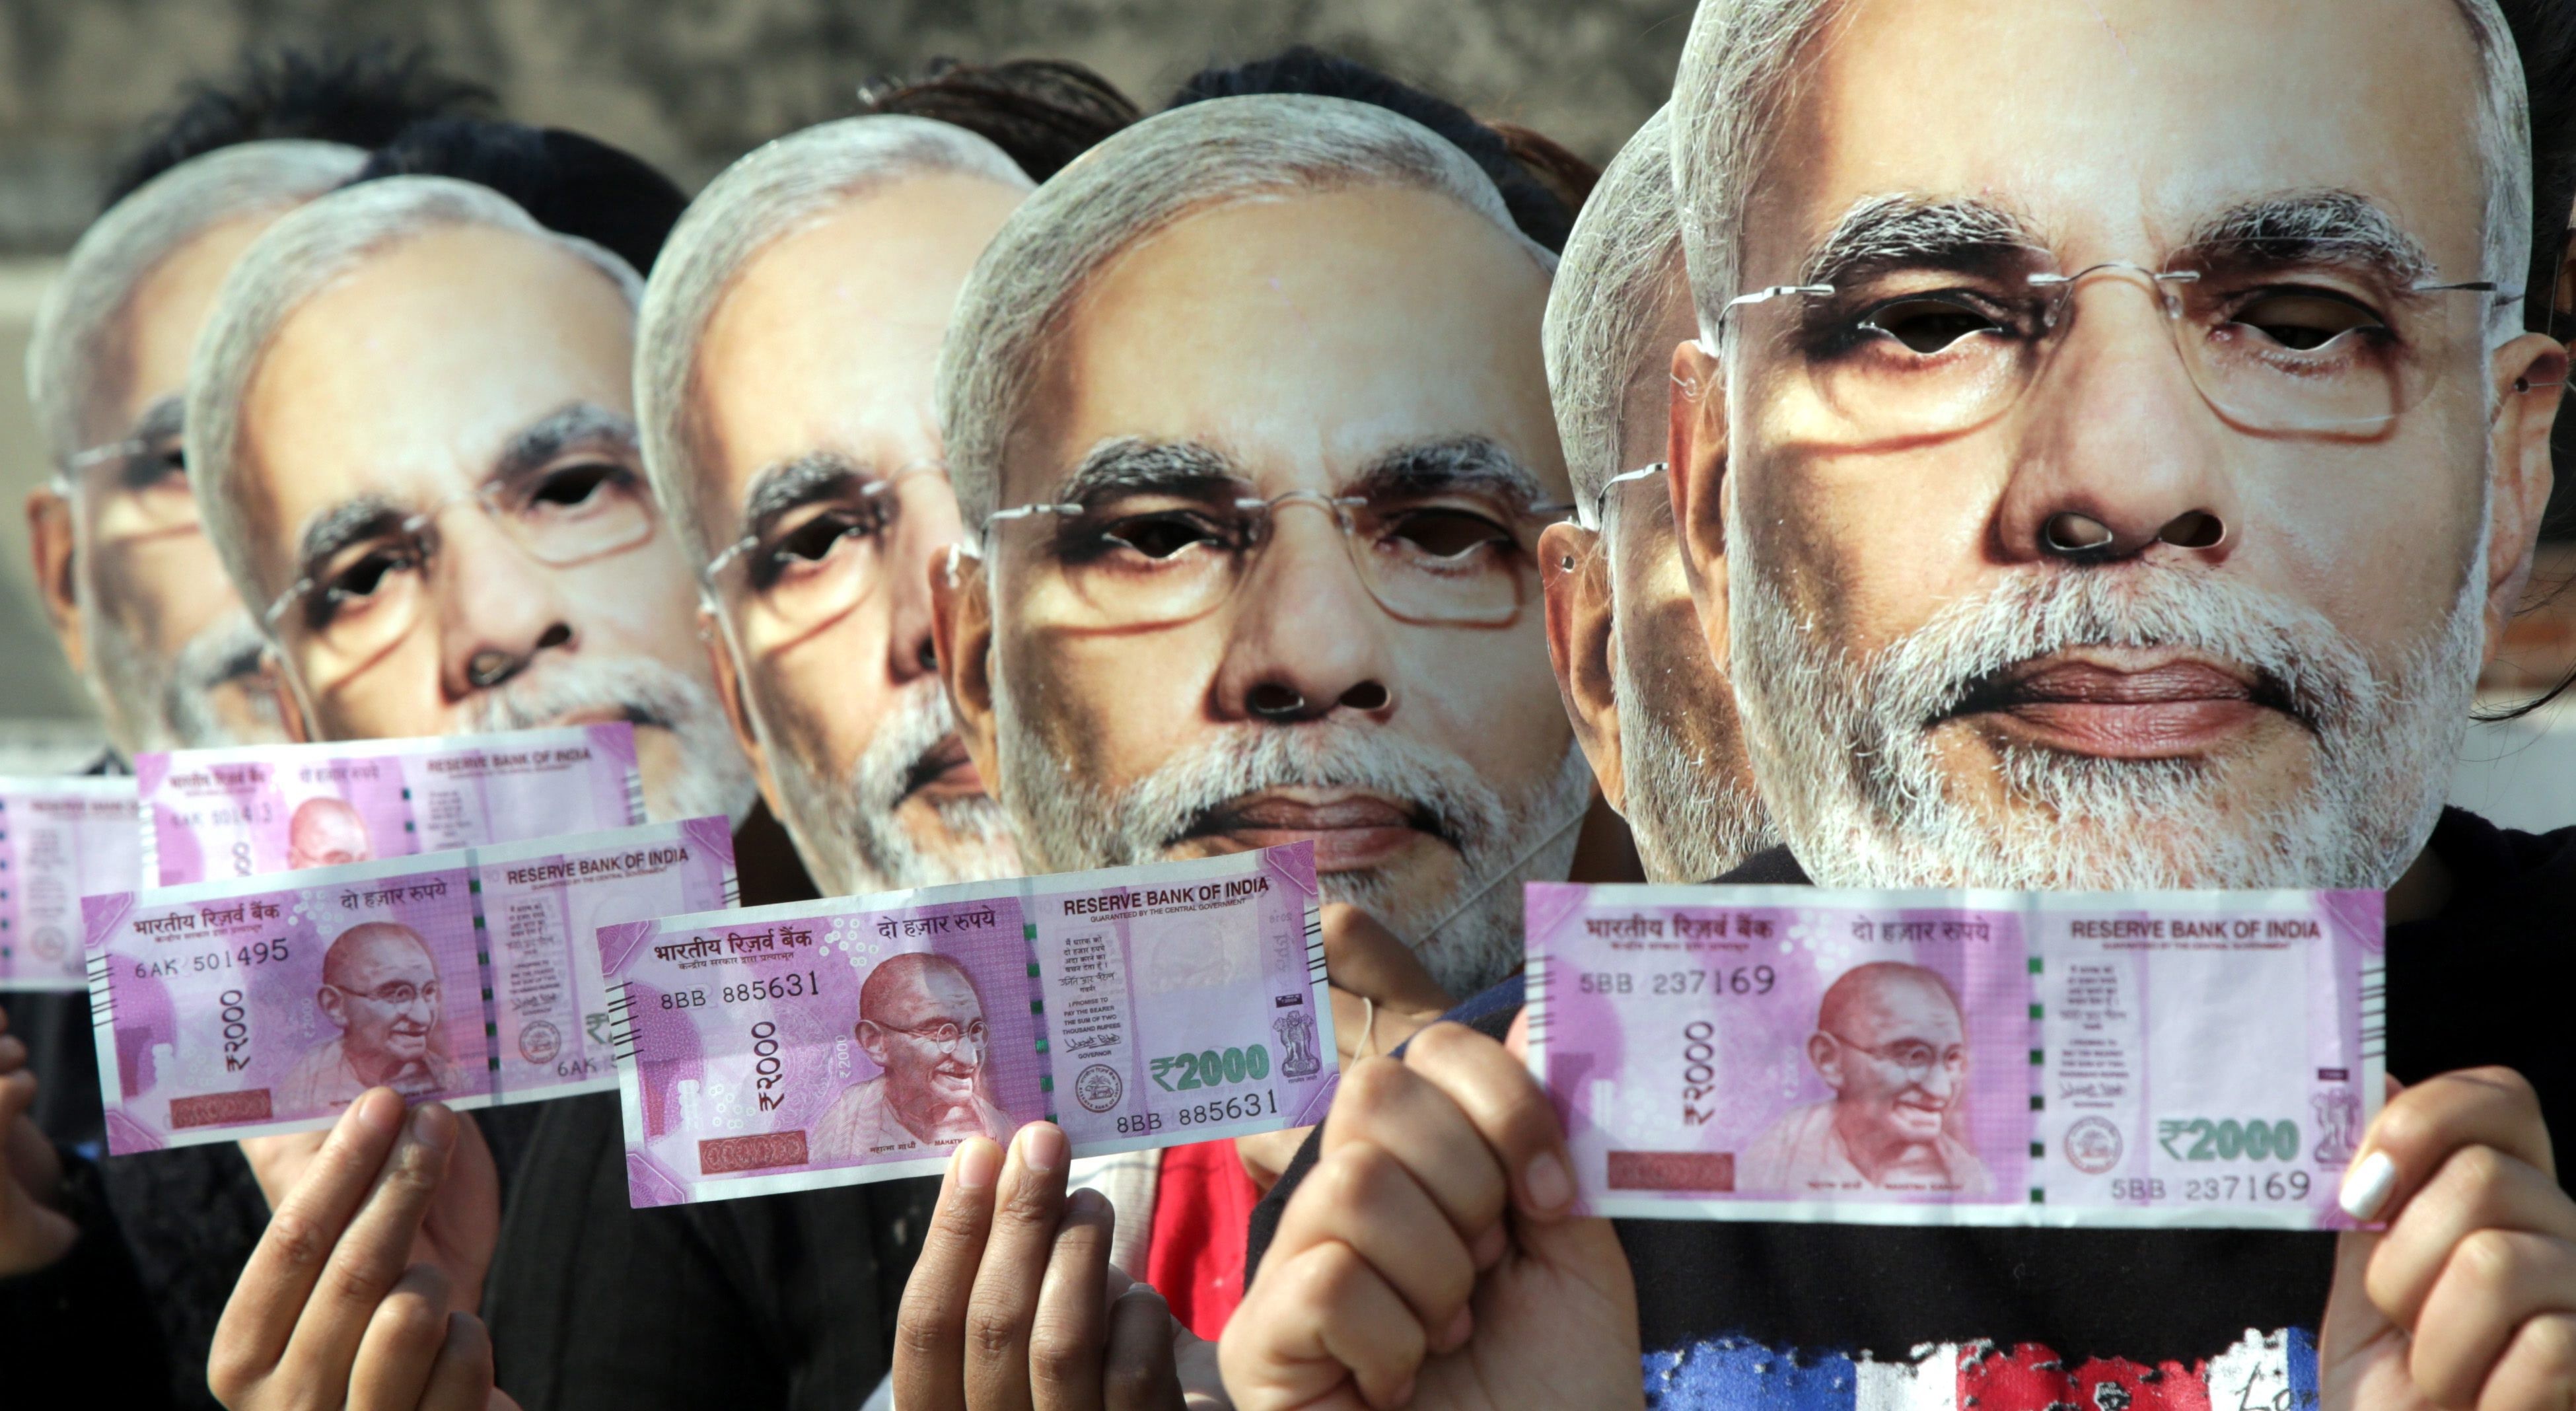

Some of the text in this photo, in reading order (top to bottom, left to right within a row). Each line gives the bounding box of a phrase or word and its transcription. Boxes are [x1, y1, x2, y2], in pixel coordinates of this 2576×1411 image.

[507, 848, 689, 885] RESERVE BANK OF INDIA
[340, 877, 447, 910] दो हज़ार रुपये
[1064, 877, 1270, 916] RESERVE BANK OF INDIA
[133, 900, 280, 935] भारतीय रिज़र्व बैंक
[877, 905, 996, 939] दो हज़ार रुपये
[1091, 911, 1137, 923] GUARANTEED
[1165, 904, 1197, 914] CENTRAL
[1198, 898, 1246, 911] GOVERNMENT
[1585, 913, 1664, 939] भारतीय
[1736, 913, 1774, 939] बैंक
[654, 925, 812, 962] भारतीय रिज़र्व बैंक
[1851, 914, 1875, 942] दो
[1943, 914, 1991, 943] रुपये
[2071, 919, 2322, 939] RESERVE BANK OF INDIA
[135, 937, 289, 979] 6AK 501495
[711, 956, 739, 968] सरकार
[661, 970, 819, 1011] 8BB 885631
[1579, 964, 1775, 995] 5BB 237169
[1072, 998, 1098, 1007] PROMISE
[1063, 1023, 1121, 1035] THOUSAND RUPEES
[557, 1058, 597, 1077] 6AK
[1078, 1050, 1112, 1059] GOVERNOR
[1149, 1044, 1270, 1092] ₹2000
[1117, 1089, 1277, 1134] 8BB 885631
[2158, 1118, 2301, 1162] ₹2000
[2111, 1170, 2311, 1201] 5BB 237169
